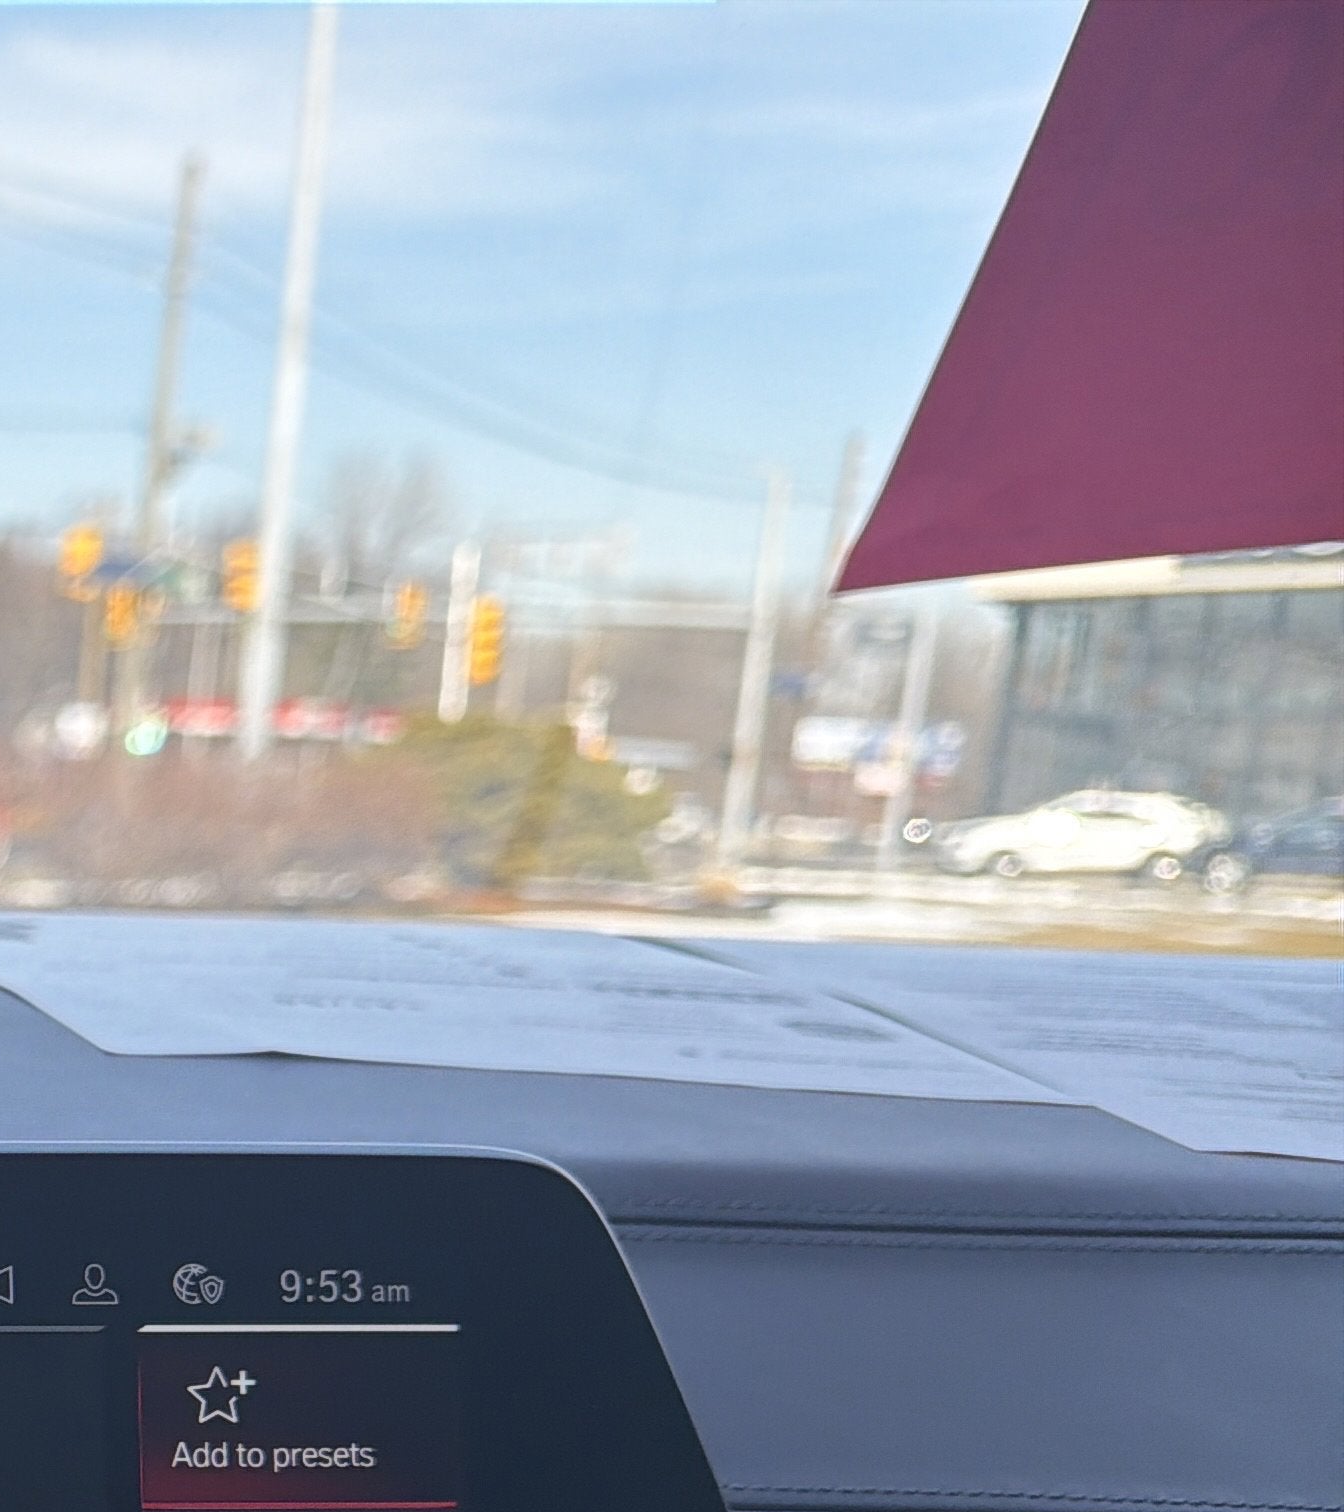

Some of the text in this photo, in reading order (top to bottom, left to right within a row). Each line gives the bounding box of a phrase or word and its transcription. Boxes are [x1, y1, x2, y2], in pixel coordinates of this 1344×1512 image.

[281, 1270, 409, 1302] 9:53 am
[172, 1442, 374, 1472] Add to presets
